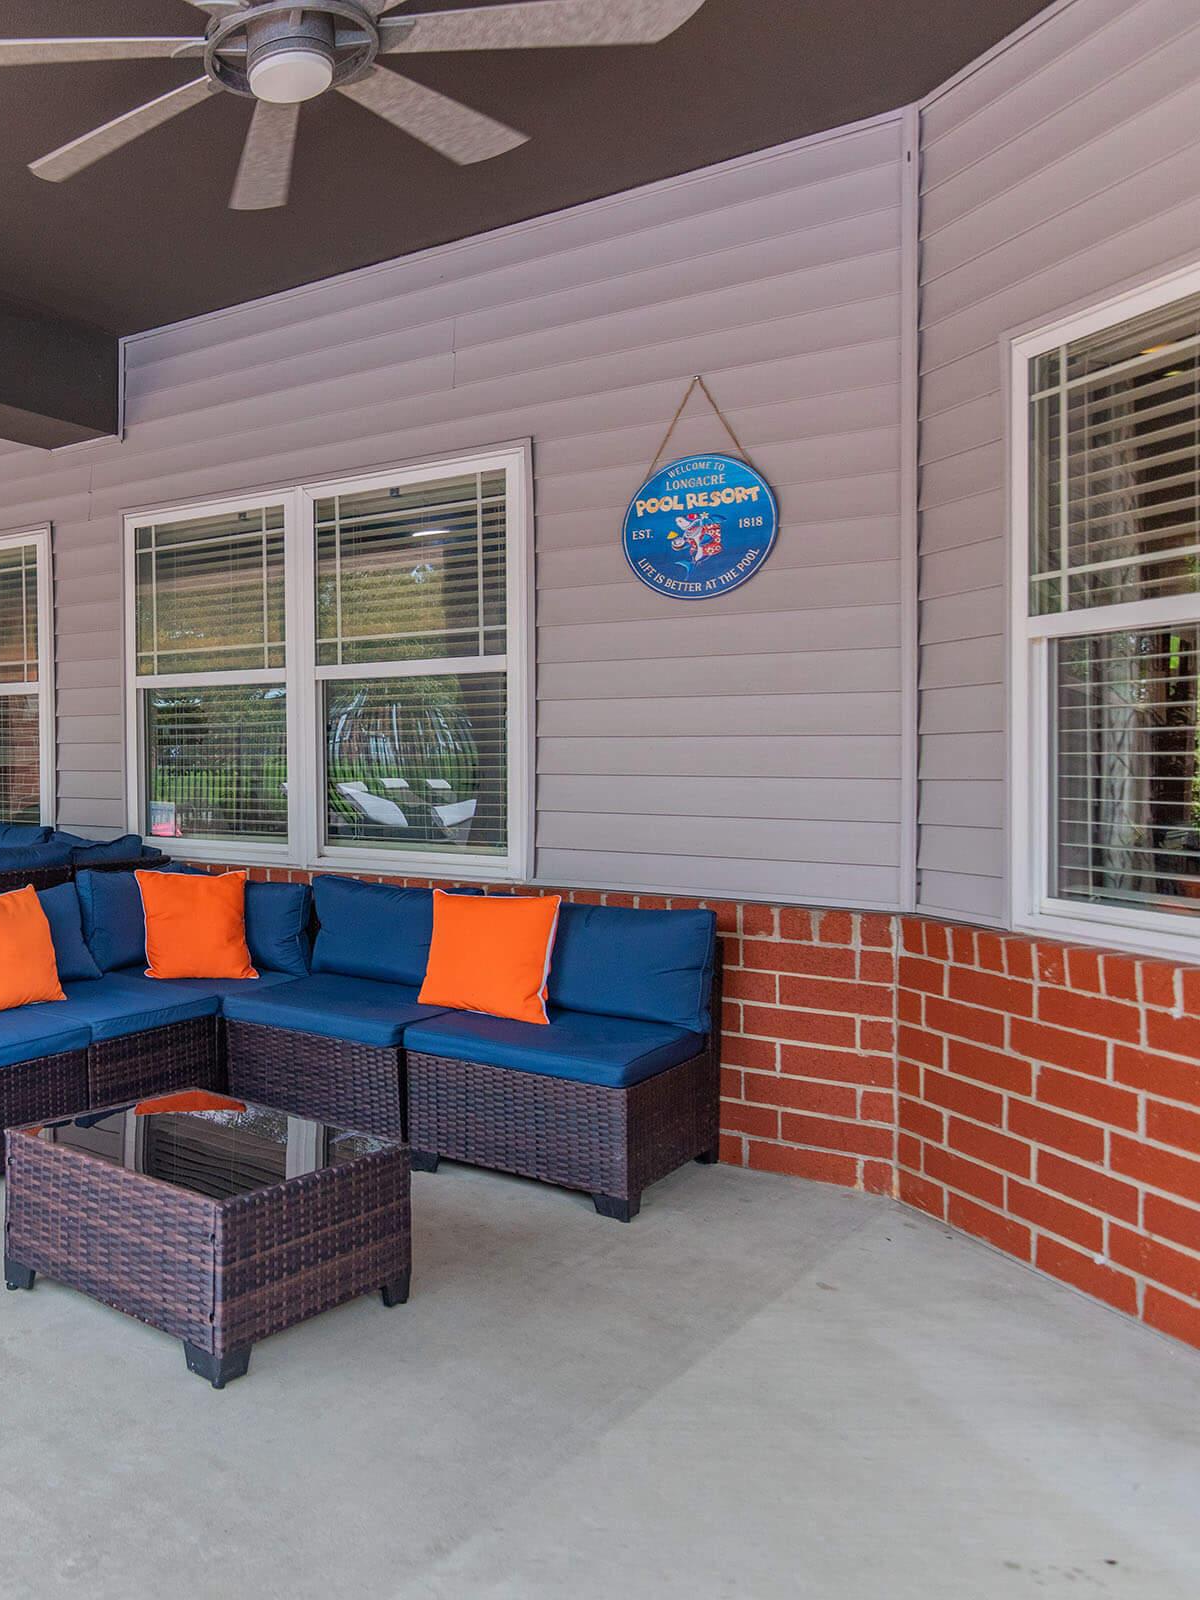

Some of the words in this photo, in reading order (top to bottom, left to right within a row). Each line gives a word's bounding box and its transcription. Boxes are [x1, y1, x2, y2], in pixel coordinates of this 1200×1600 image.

[667, 461, 711, 478] WELCOME
[713, 461, 725, 471] TO
[666, 473, 727, 491] LONGACRE
[635, 495, 684, 517] POOL
[686, 486, 760, 510] RESORT
[632, 529, 654, 540] EST.
[738, 516, 763, 528] 1818
[638, 558, 657, 578] LIFE
[653, 573, 665, 584] IS
[664, 578, 702, 592] BETTER
[705, 579, 717, 590] AT
[718, 569, 740, 584] THE
[736, 549, 760, 572] POOL
